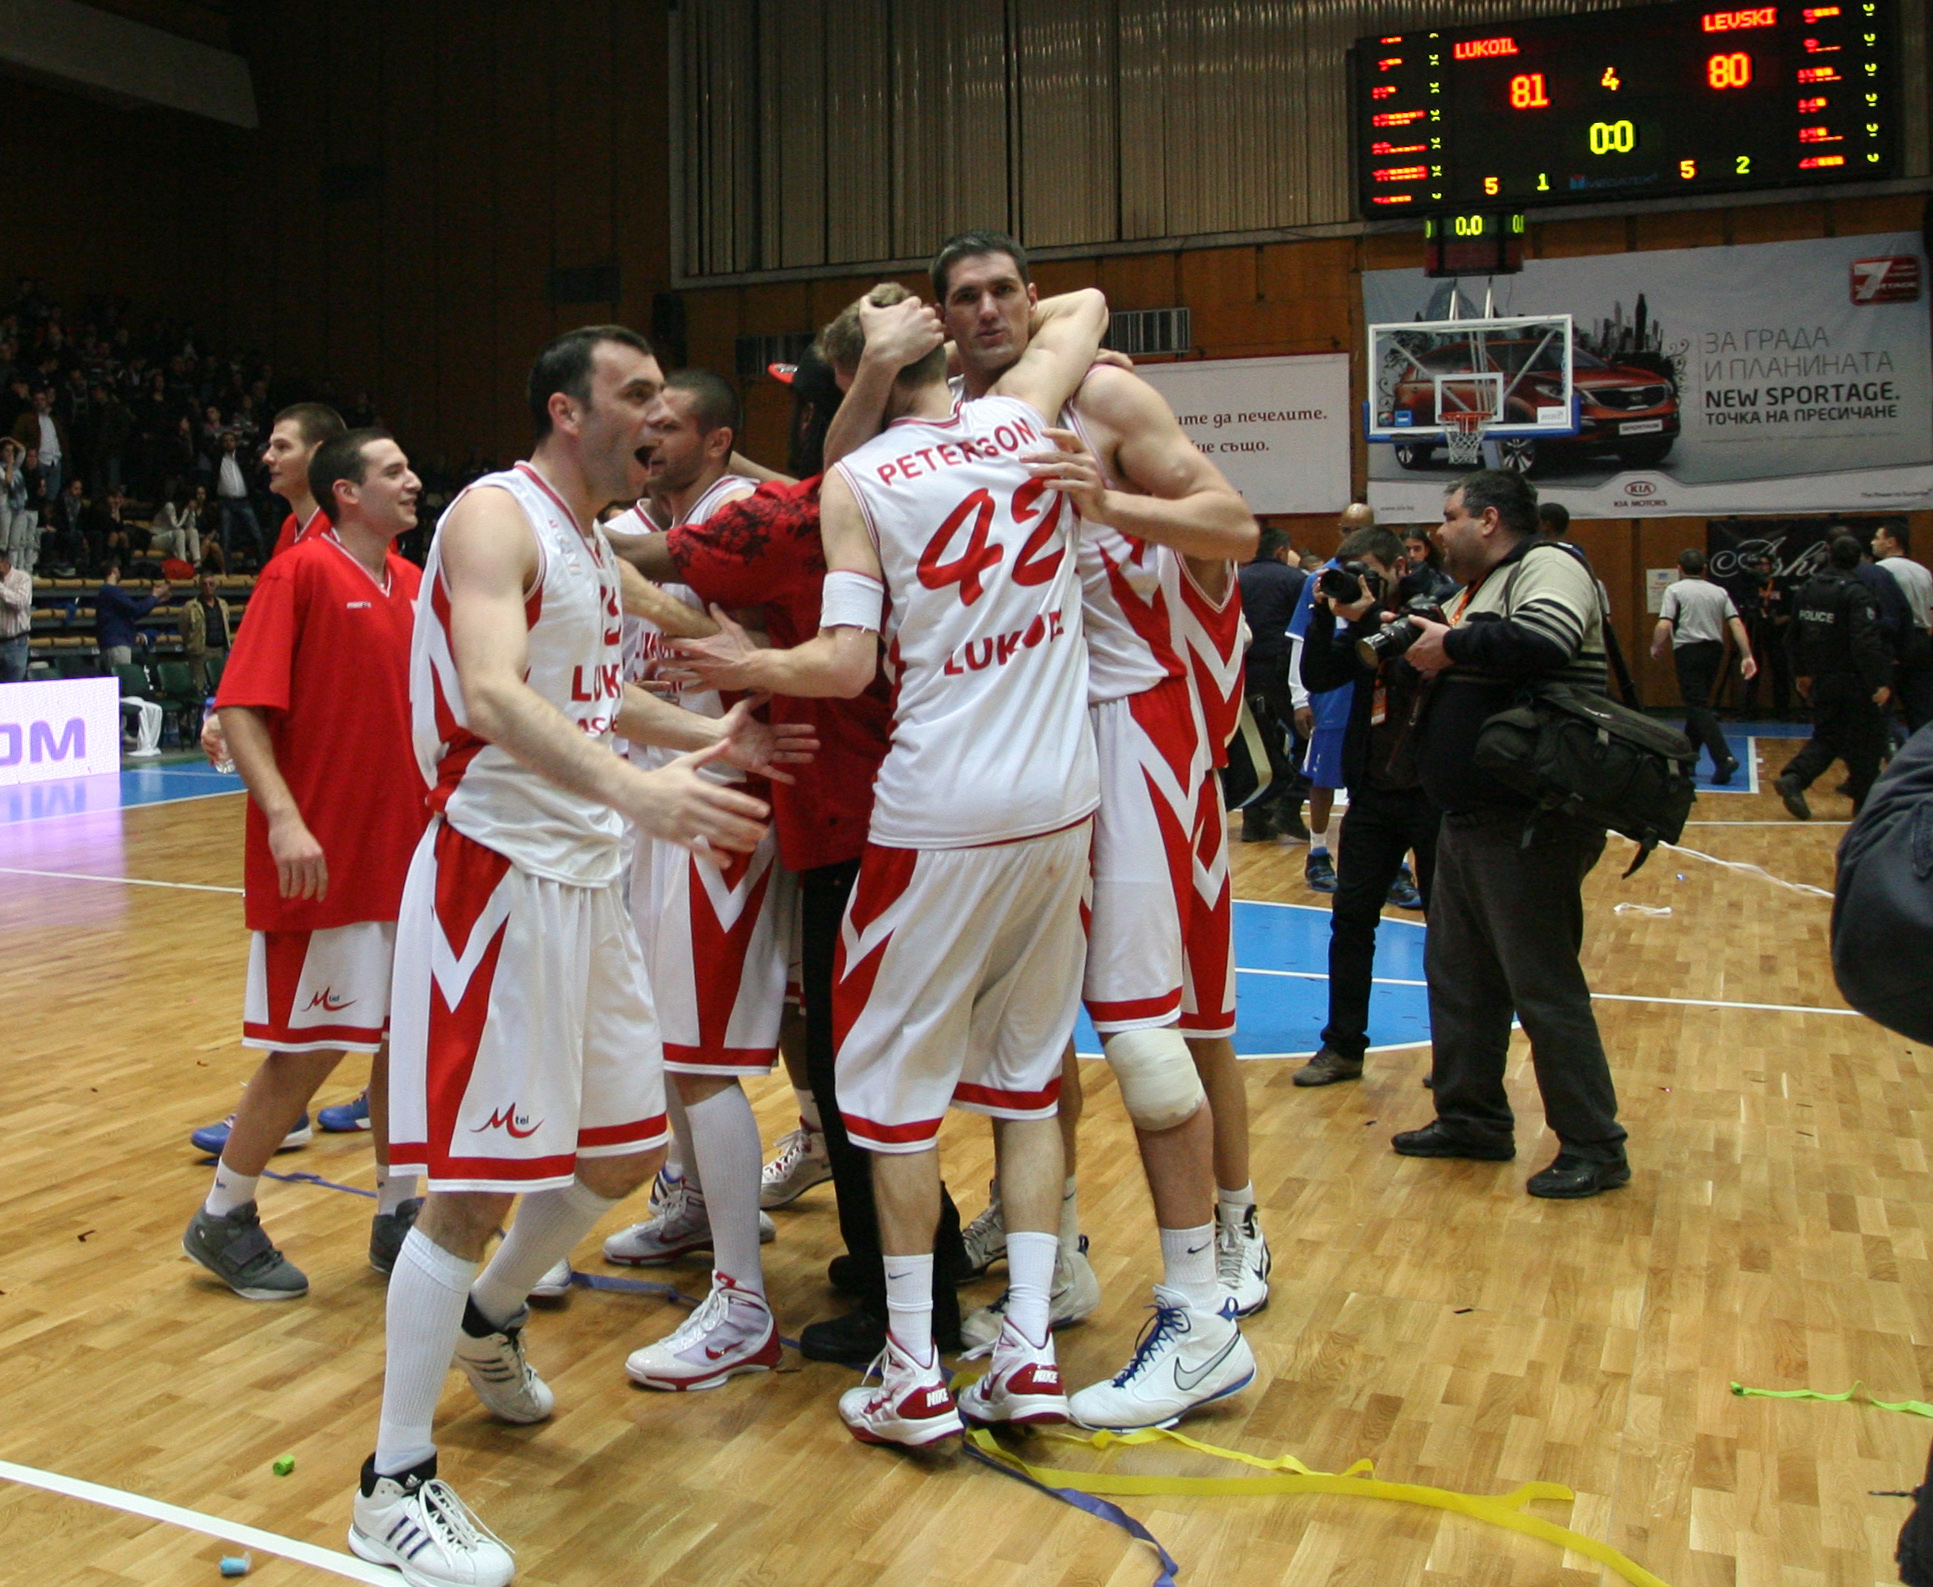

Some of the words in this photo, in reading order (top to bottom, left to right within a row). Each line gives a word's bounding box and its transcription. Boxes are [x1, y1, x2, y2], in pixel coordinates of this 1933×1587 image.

[1702, 8, 1777, 32] LEVSKI
[1454, 37, 1519, 60] LUKOIL
[1601, 66, 1621, 91] 4
[1707, 52, 1751, 89] 80
[1510, 73, 1550, 109] 81
[1680, 159, 1697, 179] 5
[1736, 155, 1750, 174] 2
[1484, 176, 1499, 195] 5
[1537, 173, 1549, 191] 1
[1455, 215, 1483, 236] 0.0
[1705, 331, 1737, 354] ЗА
[1744, 326, 1830, 350] ГРАДА
[1705, 360, 1722, 382] И
[1730, 351, 1894, 380] ПЛАНИНАТА
[1706, 389, 1758, 408] NEW
[1766, 382, 1900, 405] SPORTAGE.
[1213, 413, 1232, 428] да
[1238, 409, 1327, 424] печелите.
[1705, 410, 1761, 426] ТОЧКА
[1766, 410, 1789, 423] НА
[1795, 405, 1897, 422] ПРЕСИЧАНЕ
[877, 417, 1037, 486] PETERSON
[1220, 440, 1269, 453] също.
[1630, 484, 1652, 493] KIA
[916, 475, 1068, 607] 42
[1799, 609, 1836, 624] POLICE
[1032, 1369, 1059, 1384] NIKE
[926, 1387, 949, 1408] NIKE
